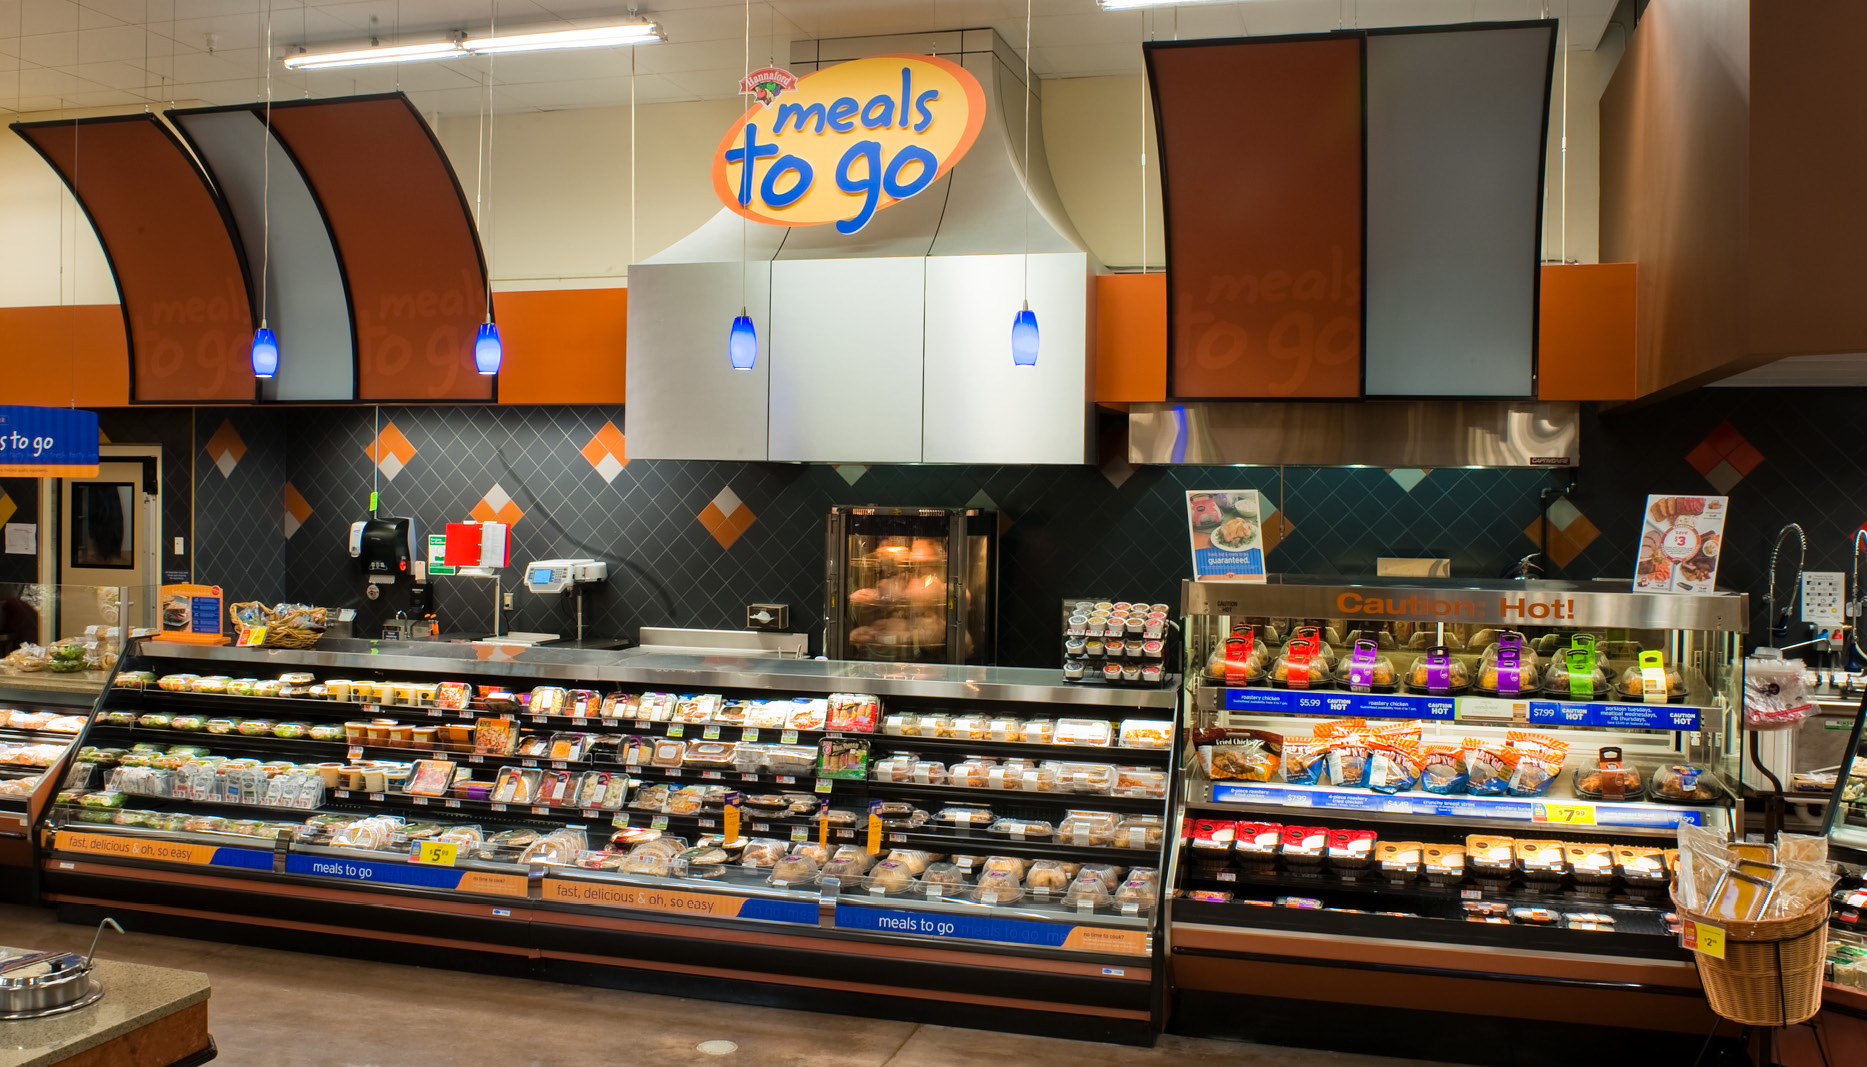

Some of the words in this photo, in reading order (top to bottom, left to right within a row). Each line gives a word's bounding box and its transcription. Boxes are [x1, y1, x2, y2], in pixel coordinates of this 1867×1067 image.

[745, 70, 791, 87] Hannaford
[772, 67, 939, 135] meals
[725, 123, 814, 208] to
[835, 140, 939, 235] go
[10, 430, 29, 449] to
[33, 436, 54, 457] go
[1674, 536, 1686, 546] $3
[1208, 556, 1250, 565] guaranteed.
[1336, 592, 1485, 616] Caution:
[1500, 597, 1574, 619] Hot!
[1299, 698, 1320, 707] $5.99
[1533, 708, 1554, 717] $7.99
[69, 836, 88, 849] fast,
[90, 839, 129, 853] delicious
[132, 843, 139, 854] &
[141, 845, 155, 856] oh,
[157, 848, 168, 857] so
[170, 849, 192, 861] easy
[313, 861, 343, 876] meals
[345, 865, 356, 877] to
[358, 868, 372, 880] go
[557, 884, 581, 899] fast,
[584, 887, 634, 904] delicious
[637, 892, 646, 904] &
[649, 893, 667, 908] oh,
[670, 898, 684, 908] so
[686, 899, 714, 913] easy
[878, 914, 917, 931] meals
[920, 919, 934, 932] to
[937, 921, 954, 936] go
